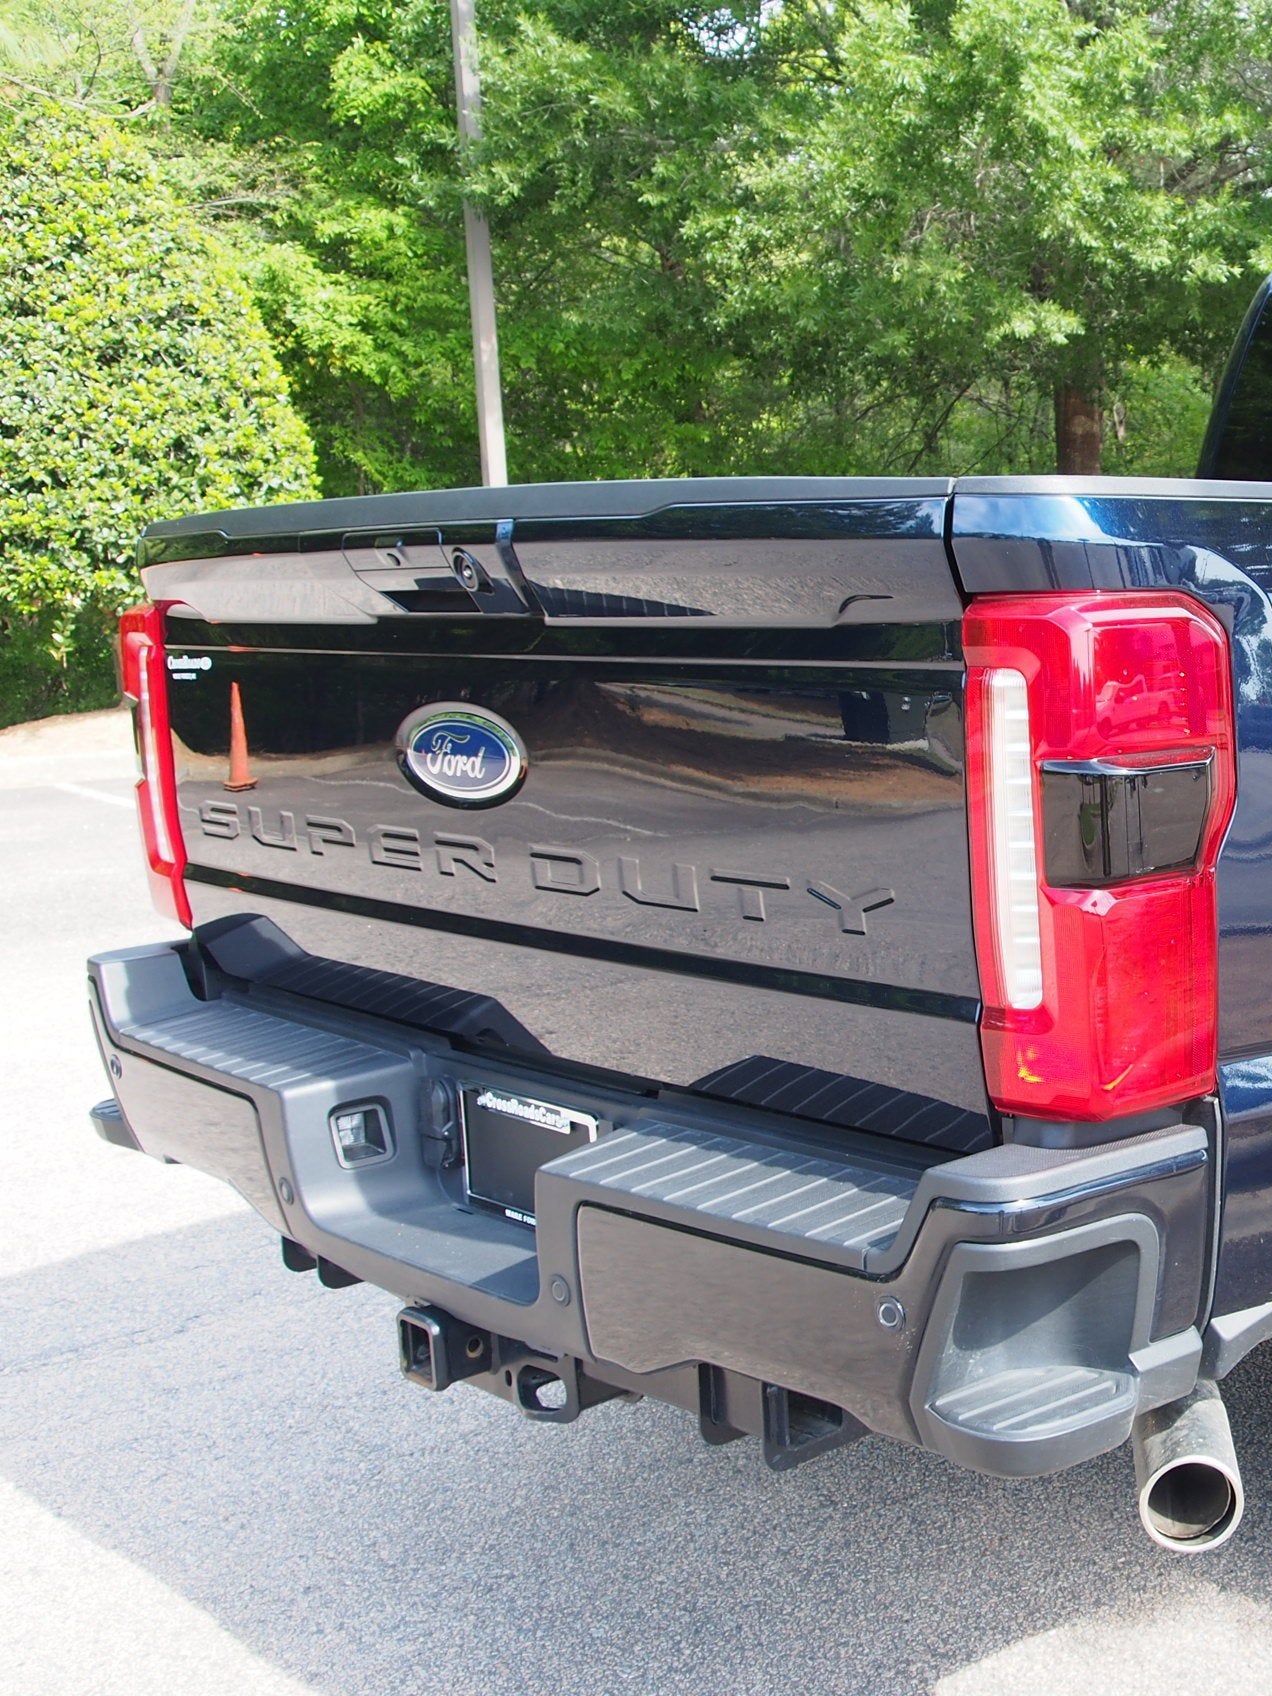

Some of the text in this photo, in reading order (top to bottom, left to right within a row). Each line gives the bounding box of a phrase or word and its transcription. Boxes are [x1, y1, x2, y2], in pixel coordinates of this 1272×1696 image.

[426, 730, 486, 779] Ford
[200, 799, 896, 936] SUPER DUTY
